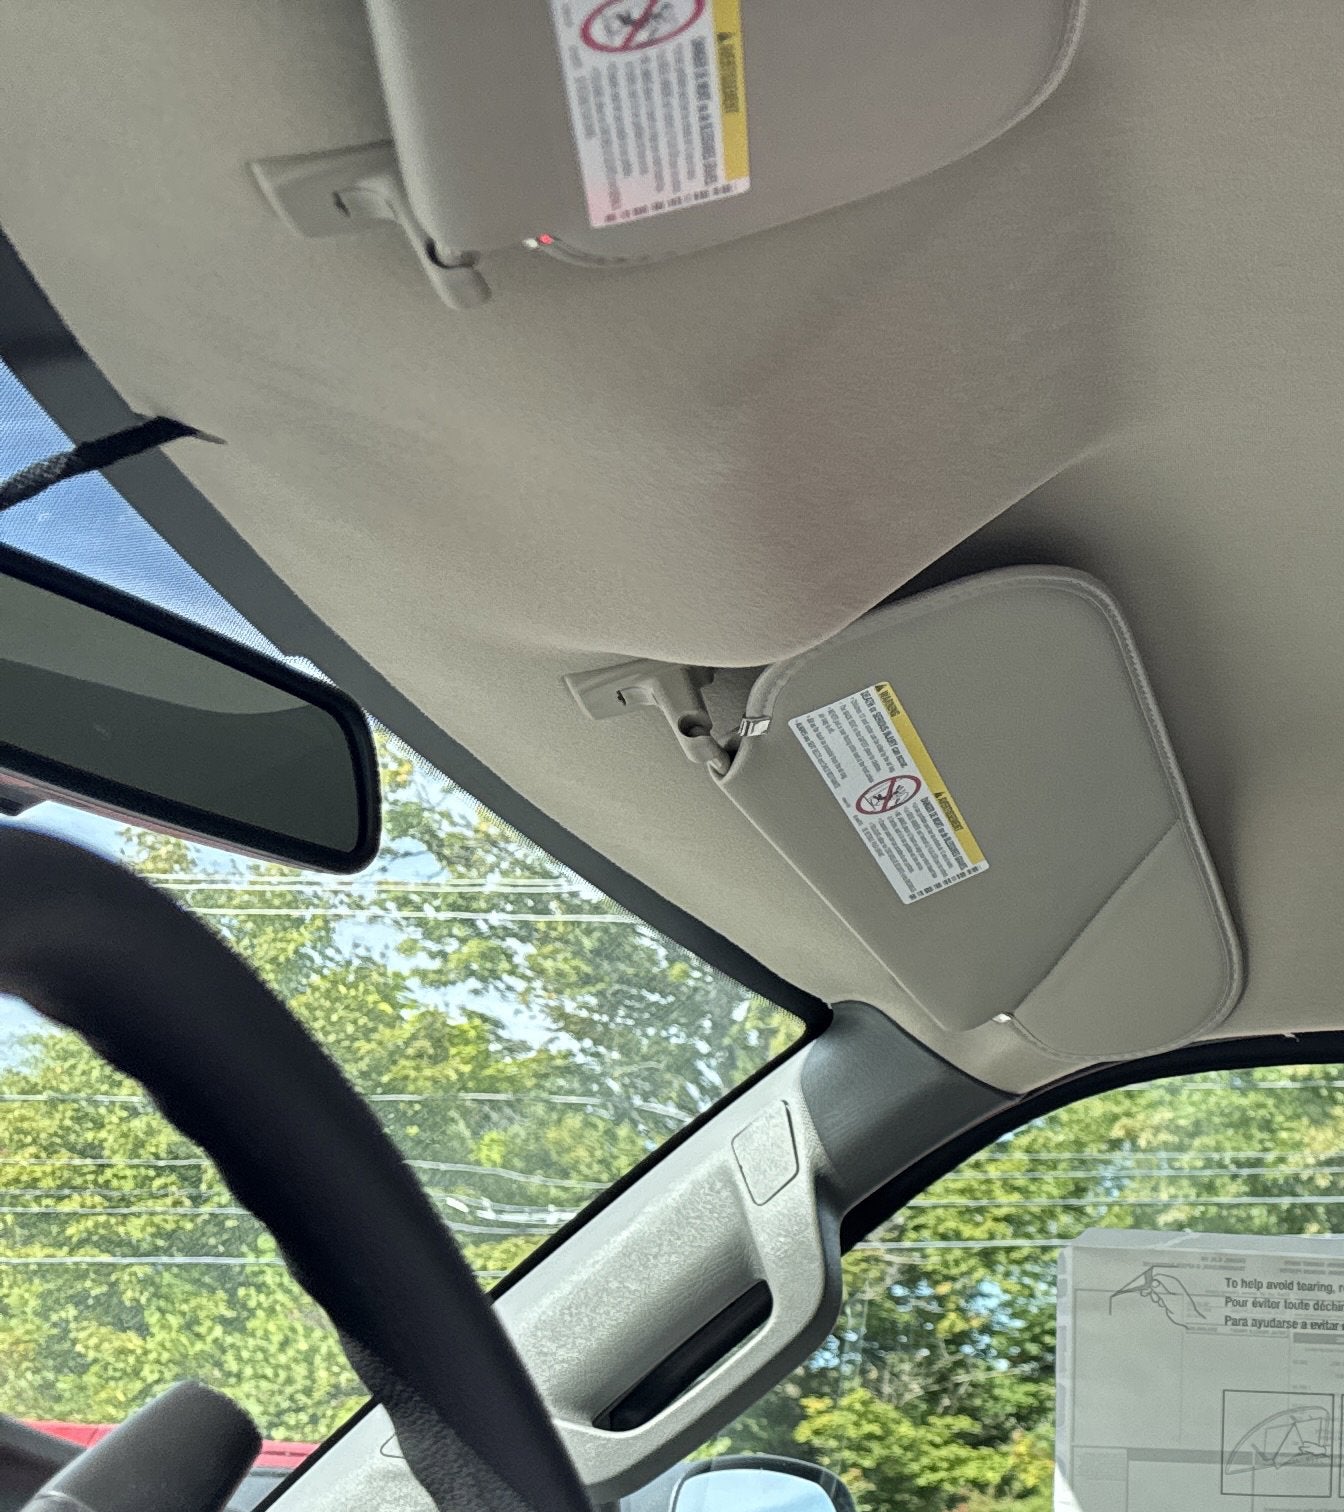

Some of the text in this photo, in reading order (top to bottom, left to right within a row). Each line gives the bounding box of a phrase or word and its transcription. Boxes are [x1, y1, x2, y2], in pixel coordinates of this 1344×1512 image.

[878, 689, 901, 717] WARNING
[1224, 1277, 1238, 1289] To
[1241, 1278, 1263, 1291] help
[1266, 1280, 1294, 1291] avoid
[1297, 1281, 1336, 1295] tearing,
[1225, 1296, 1248, 1308] Pour
[1284, 1299, 1310, 1311] toute
[1225, 1315, 1248, 1327] Para
[1251, 1317, 1299, 1330] ayudarse
[1301, 1321, 1308, 1330] a
[1311, 1320, 1339, 1331] evitar
